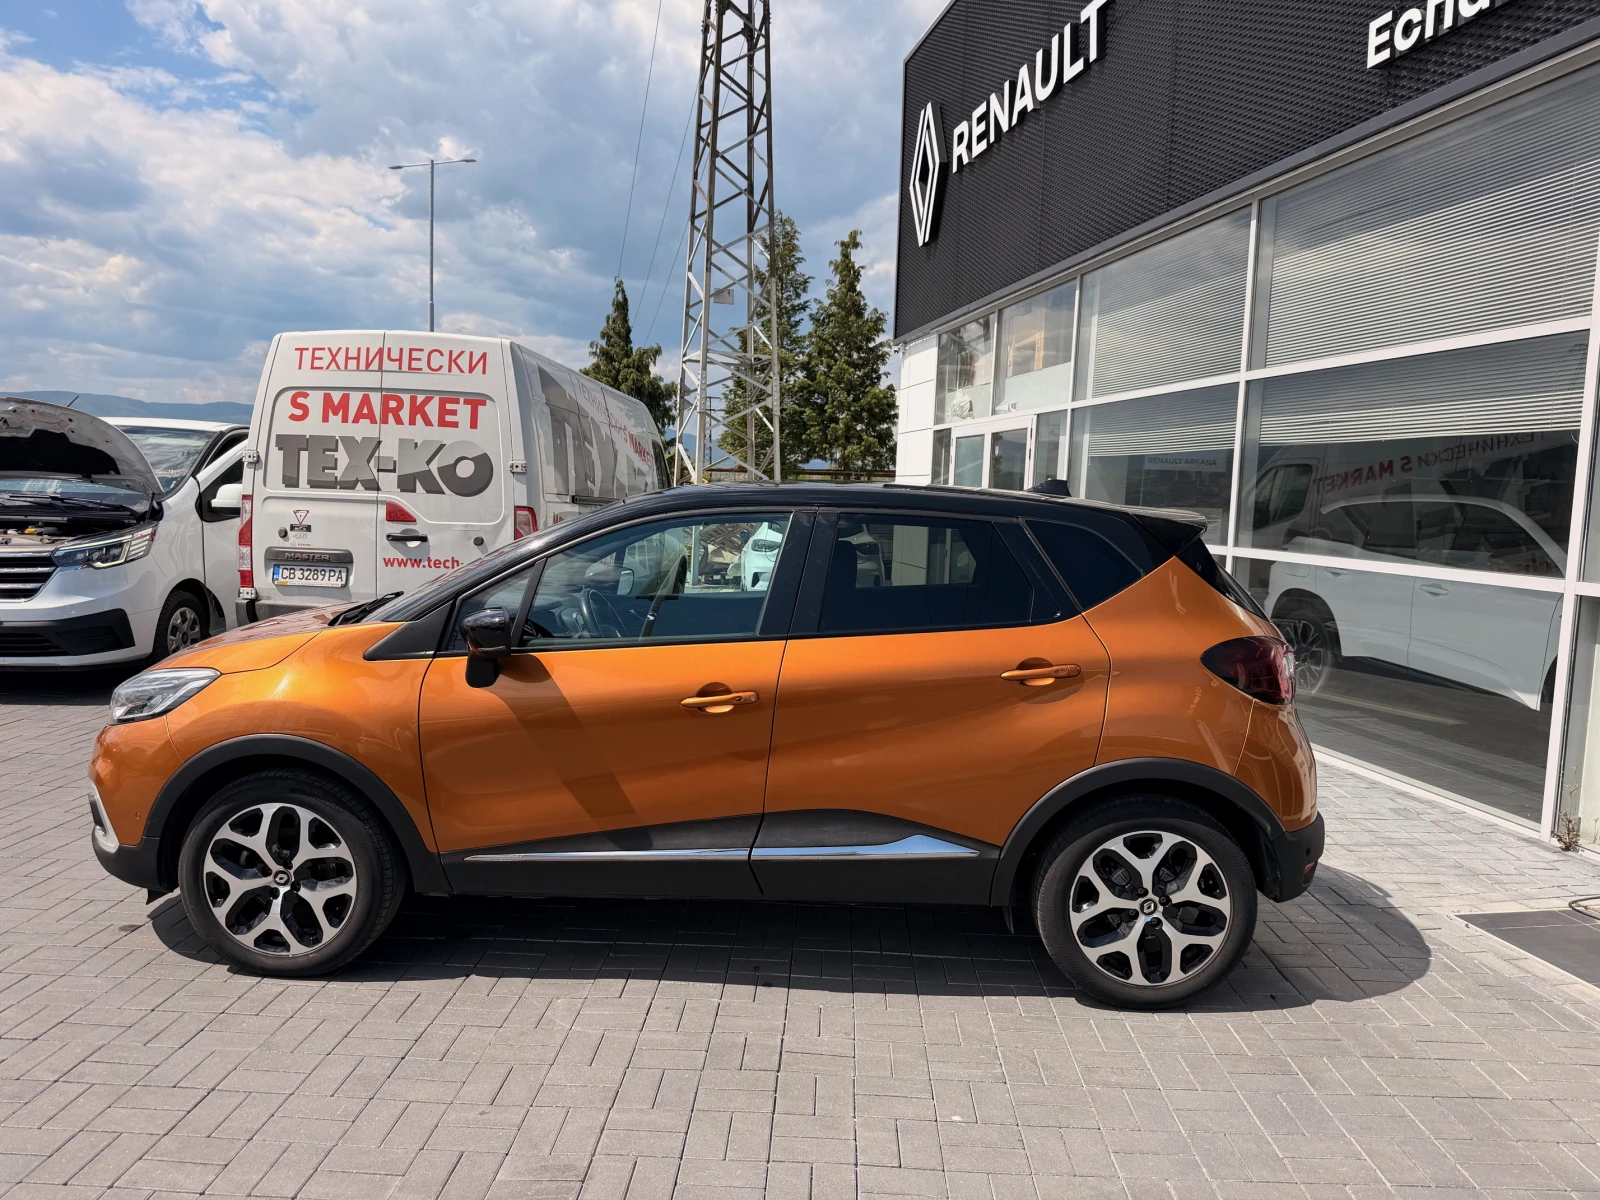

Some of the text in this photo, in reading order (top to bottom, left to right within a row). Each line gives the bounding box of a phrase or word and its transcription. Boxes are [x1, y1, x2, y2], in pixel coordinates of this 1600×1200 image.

[952, 0, 1108, 174] RENAULT
[294, 346, 488, 375] ТЕХНИЧЕСКИ
[287, 390, 487, 430] S MARKET
[1148, 457, 1217, 466] RENAULT ARKANA
[284, 552, 330, 562] MASTER
[281, 567, 343, 582] CB 3289 PA
